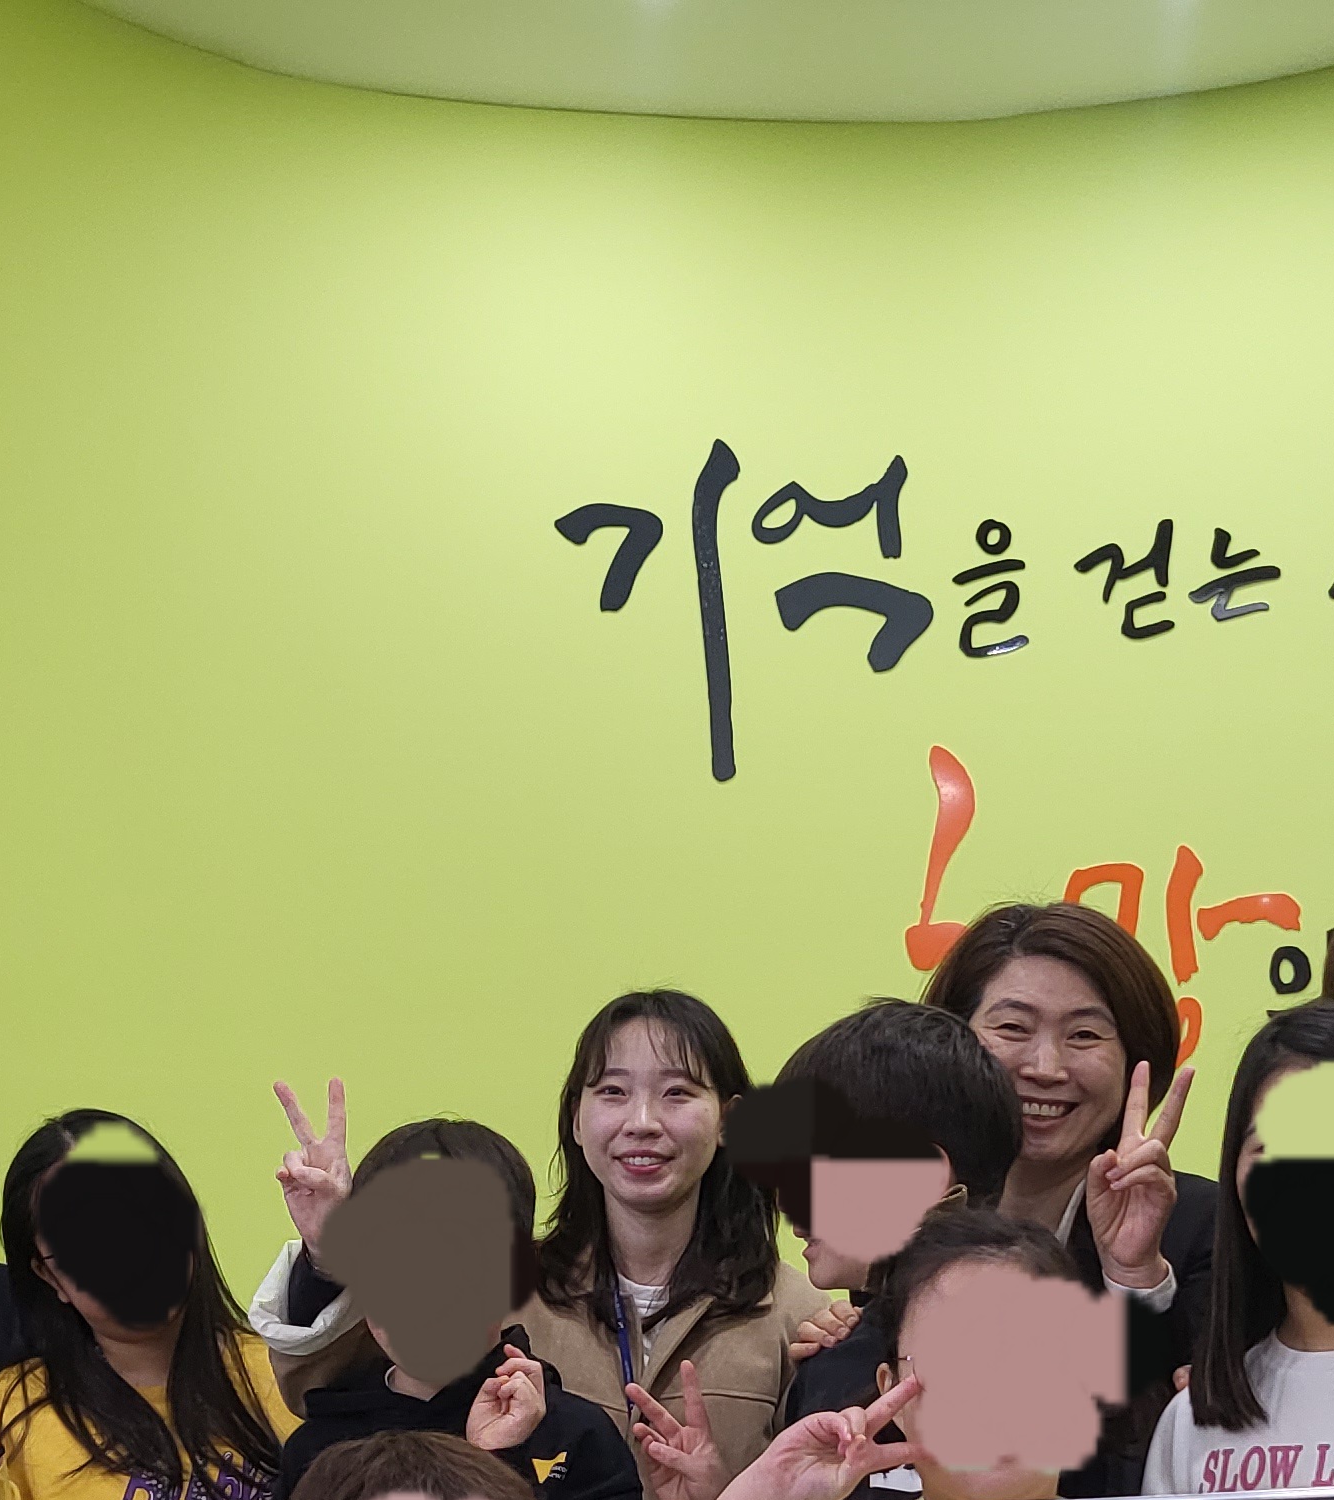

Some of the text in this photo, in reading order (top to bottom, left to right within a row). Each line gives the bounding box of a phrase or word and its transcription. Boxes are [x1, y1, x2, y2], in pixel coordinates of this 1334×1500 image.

[554, 438, 1030, 783] 기억을
[1073, 518, 1282, 639] 걷는
[1199, 1444, 1303, 1495] SLOW
